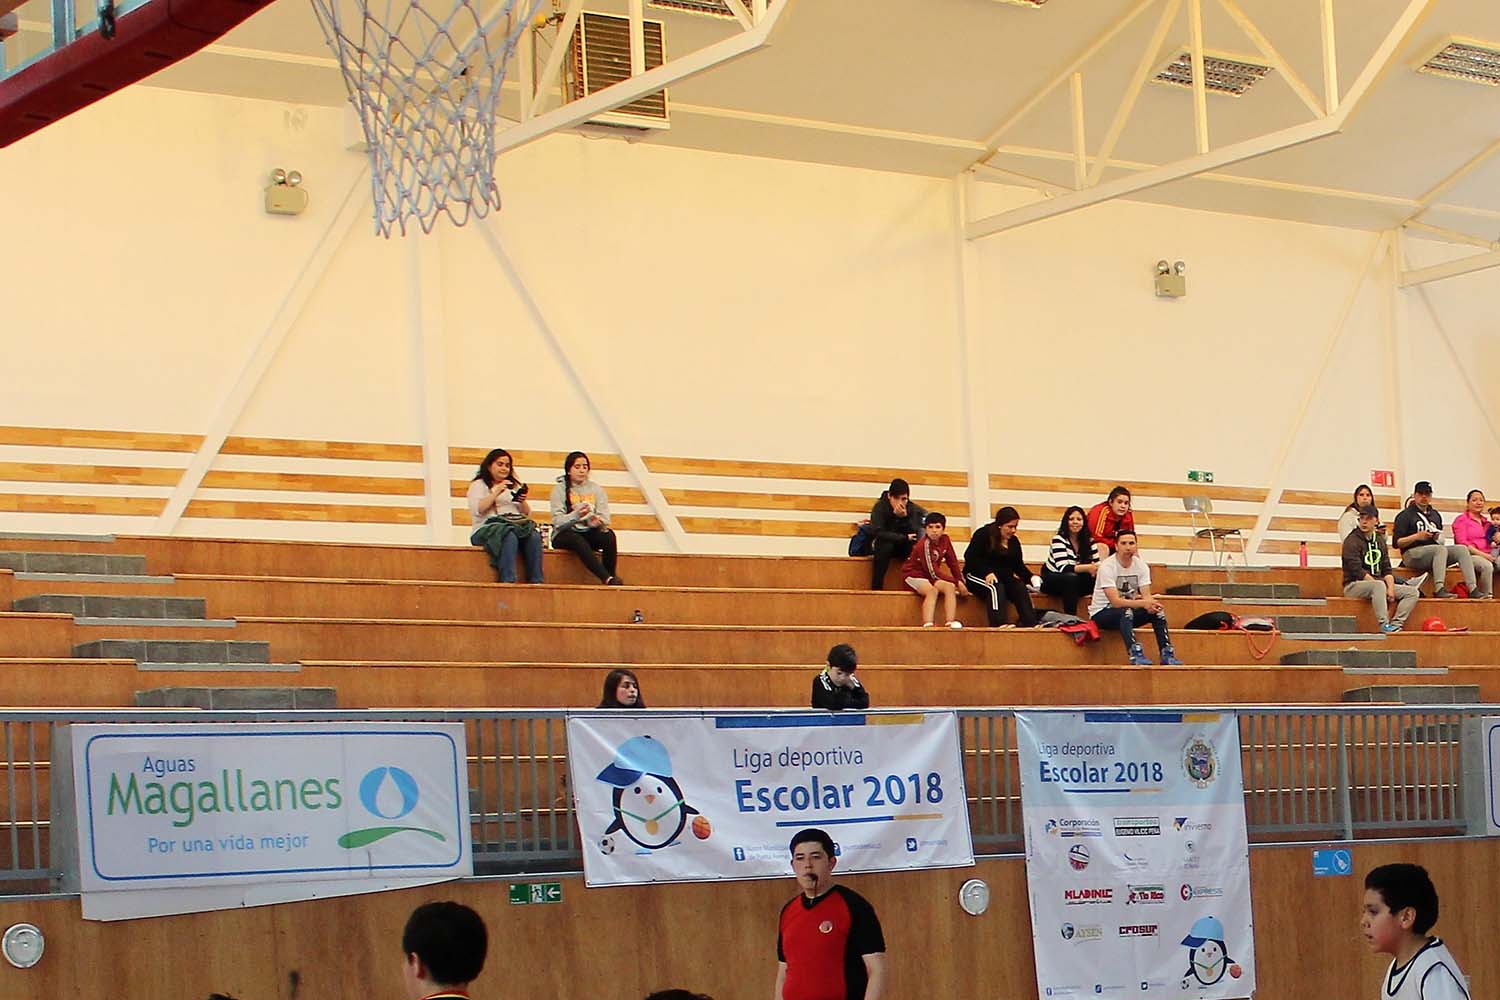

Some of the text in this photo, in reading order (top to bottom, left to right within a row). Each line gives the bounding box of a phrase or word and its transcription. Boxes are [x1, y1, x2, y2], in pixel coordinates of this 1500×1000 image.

[733, 746, 863, 773] Liga deportiva
[1062, 742, 1115, 758] deportiva
[143, 756, 195, 777] Aguas
[1040, 761, 1163, 783] Escolar 2018
[107, 769, 342, 827] Magallanes
[735, 772, 943, 813] Escolar 2018
[148, 834, 309, 853] Por una vida mejor
